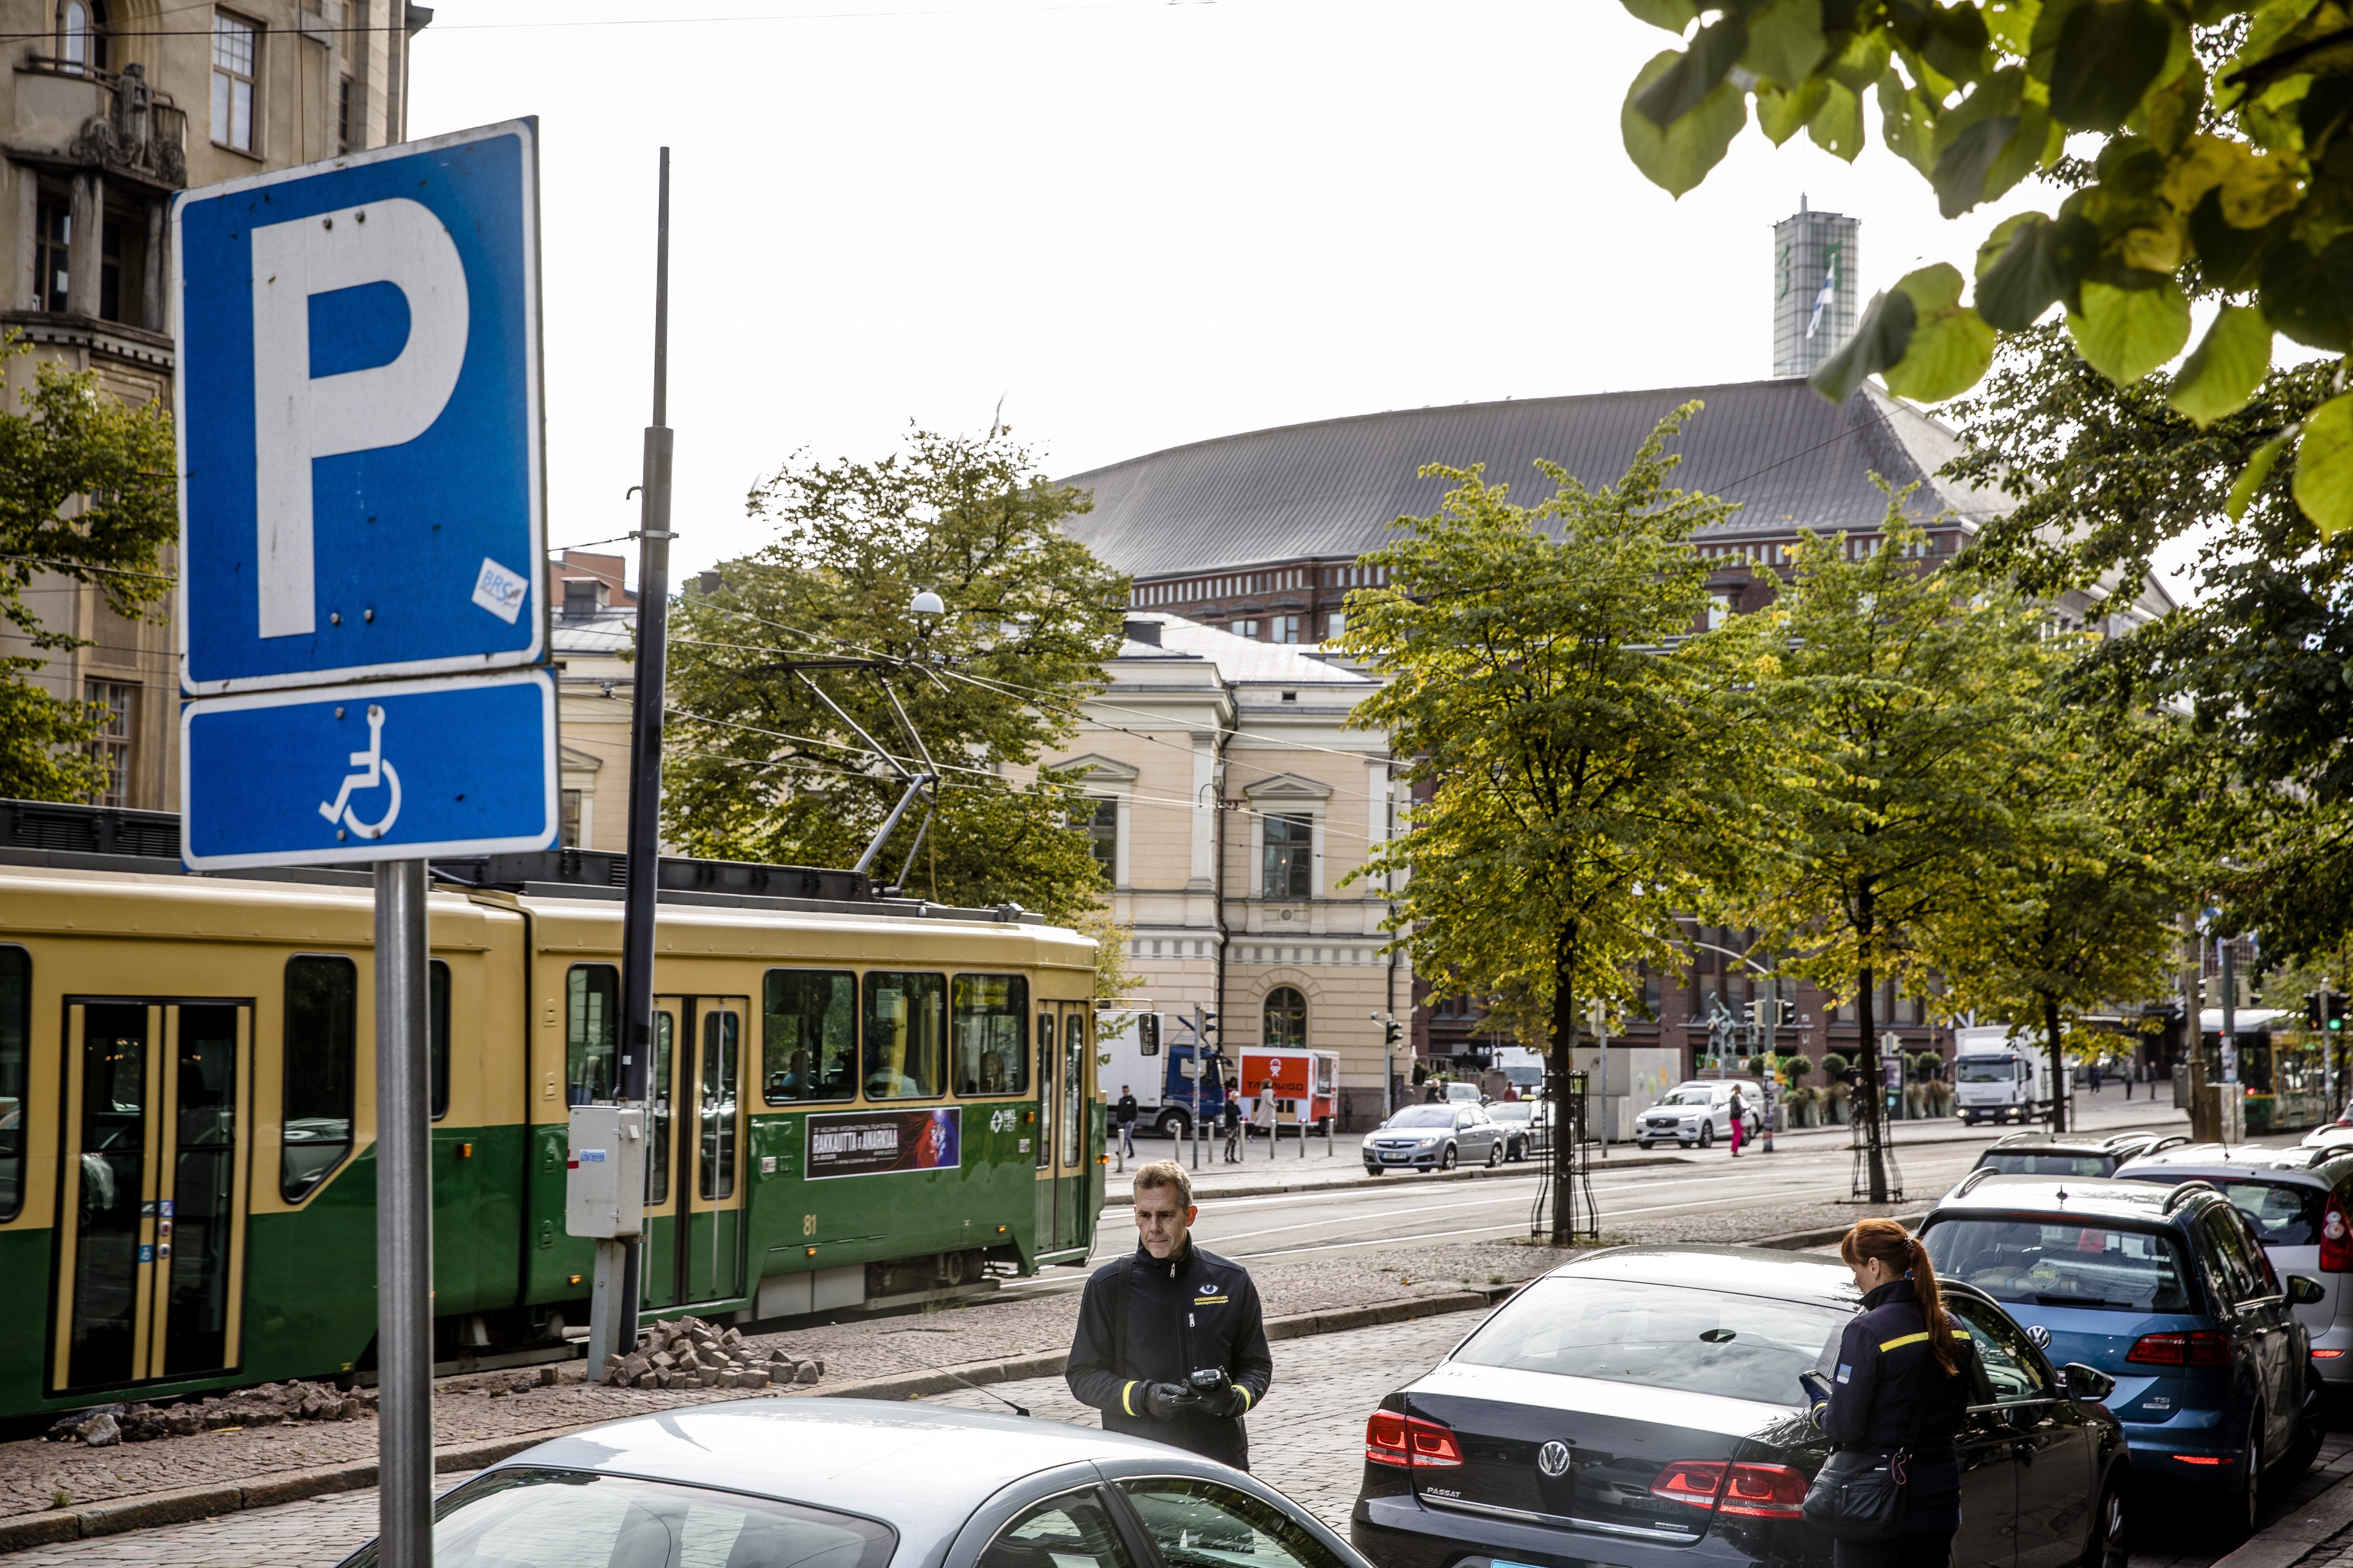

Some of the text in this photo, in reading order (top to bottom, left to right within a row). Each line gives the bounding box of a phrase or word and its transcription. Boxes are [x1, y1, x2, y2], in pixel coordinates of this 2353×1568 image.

[251, 197, 469, 638] P
[803, 1214, 816, 1236] 81
[1427, 1487, 1461, 1497] PASSAT
